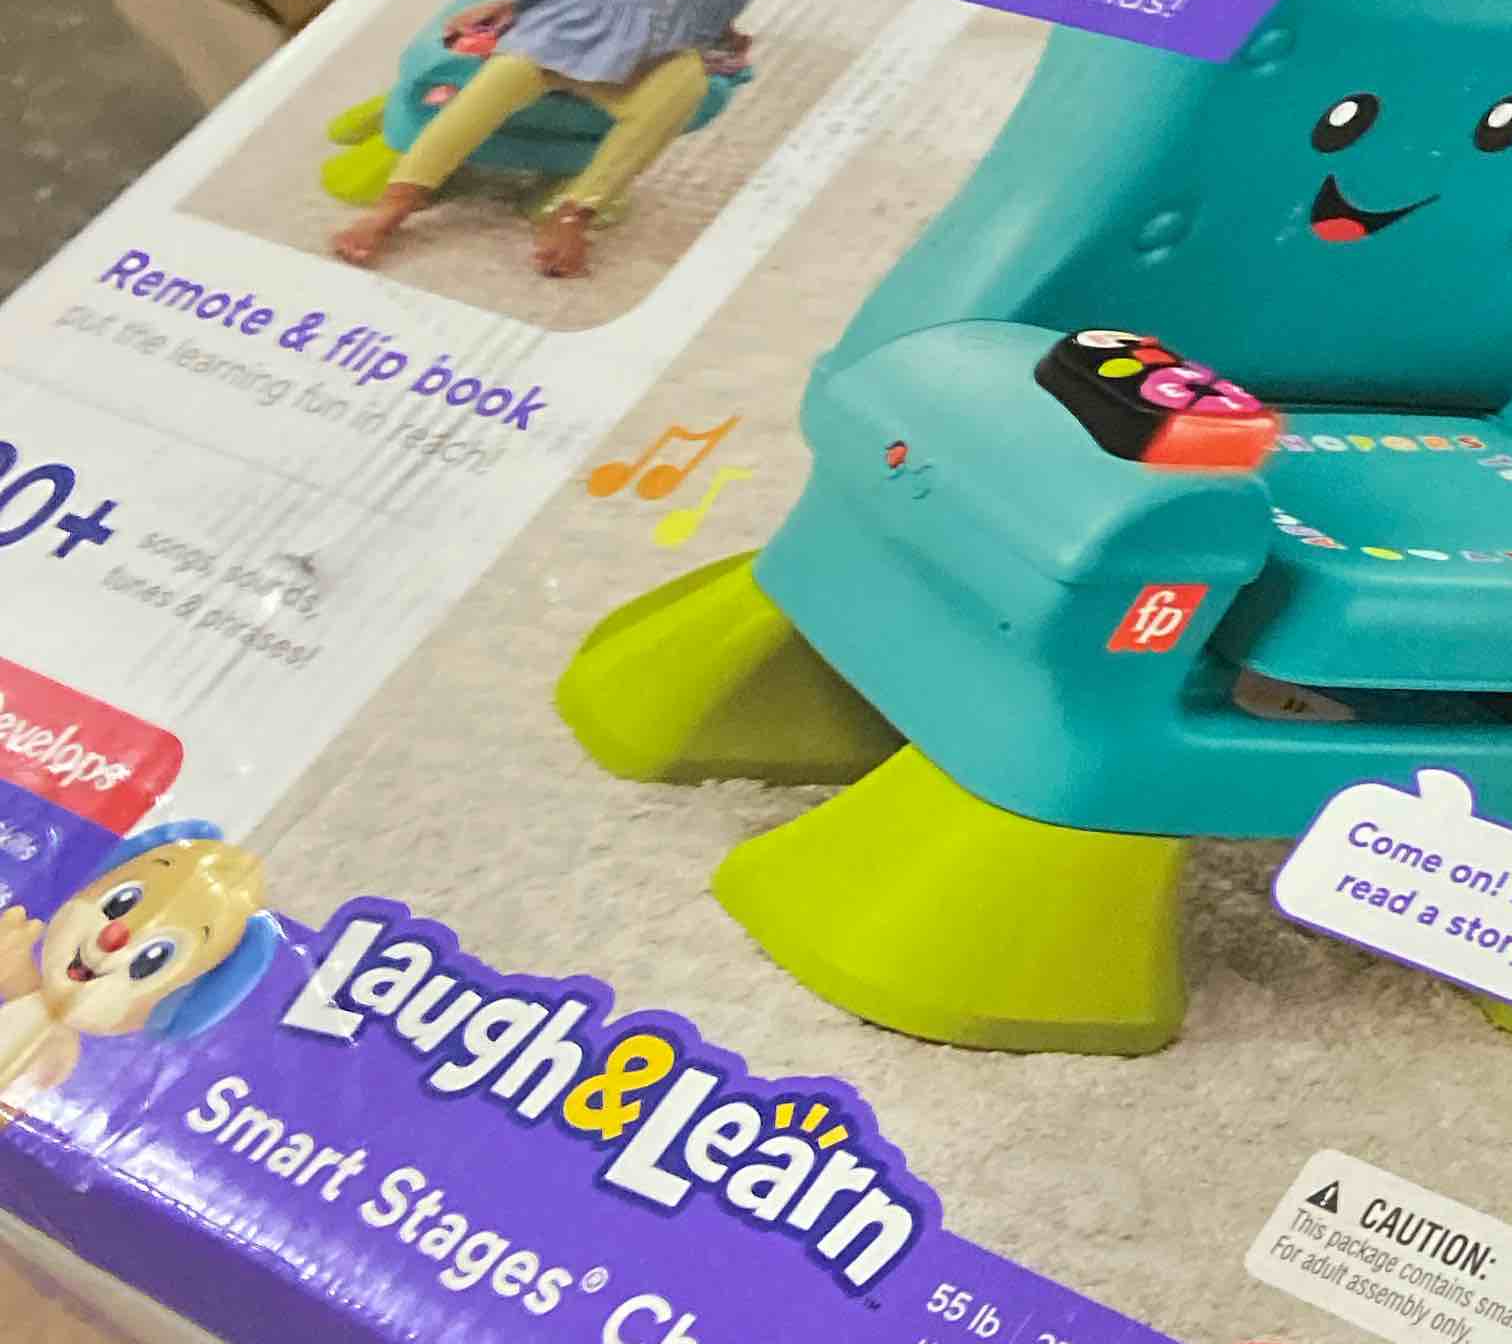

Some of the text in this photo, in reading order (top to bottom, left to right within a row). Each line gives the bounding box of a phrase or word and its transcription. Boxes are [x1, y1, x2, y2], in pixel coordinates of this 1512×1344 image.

[97, 248, 548, 430] Remote & flip book
[170, 336, 290, 407] learning
[1132, 590, 1185, 644] fp
[1348, 821, 1443, 873] Come
[1449, 864, 1510, 897] on!
[1335, 875, 1418, 915] read
[1417, 905, 1440, 926] a
[185, 1075, 369, 1202] Smart
[1289, 1208, 1327, 1240] This
[1326, 1227, 1398, 1274] package
[1400, 1261, 1474, 1307] contains
[1359, 1198, 1497, 1280] CAUTION:
[927, 1283, 973, 1321] 55
[968, 1303, 1000, 1338] lb
[1270, 1234, 1303, 1262] For
[1301, 1251, 1349, 1285] adult
[1346, 1272, 1430, 1326] assembly
